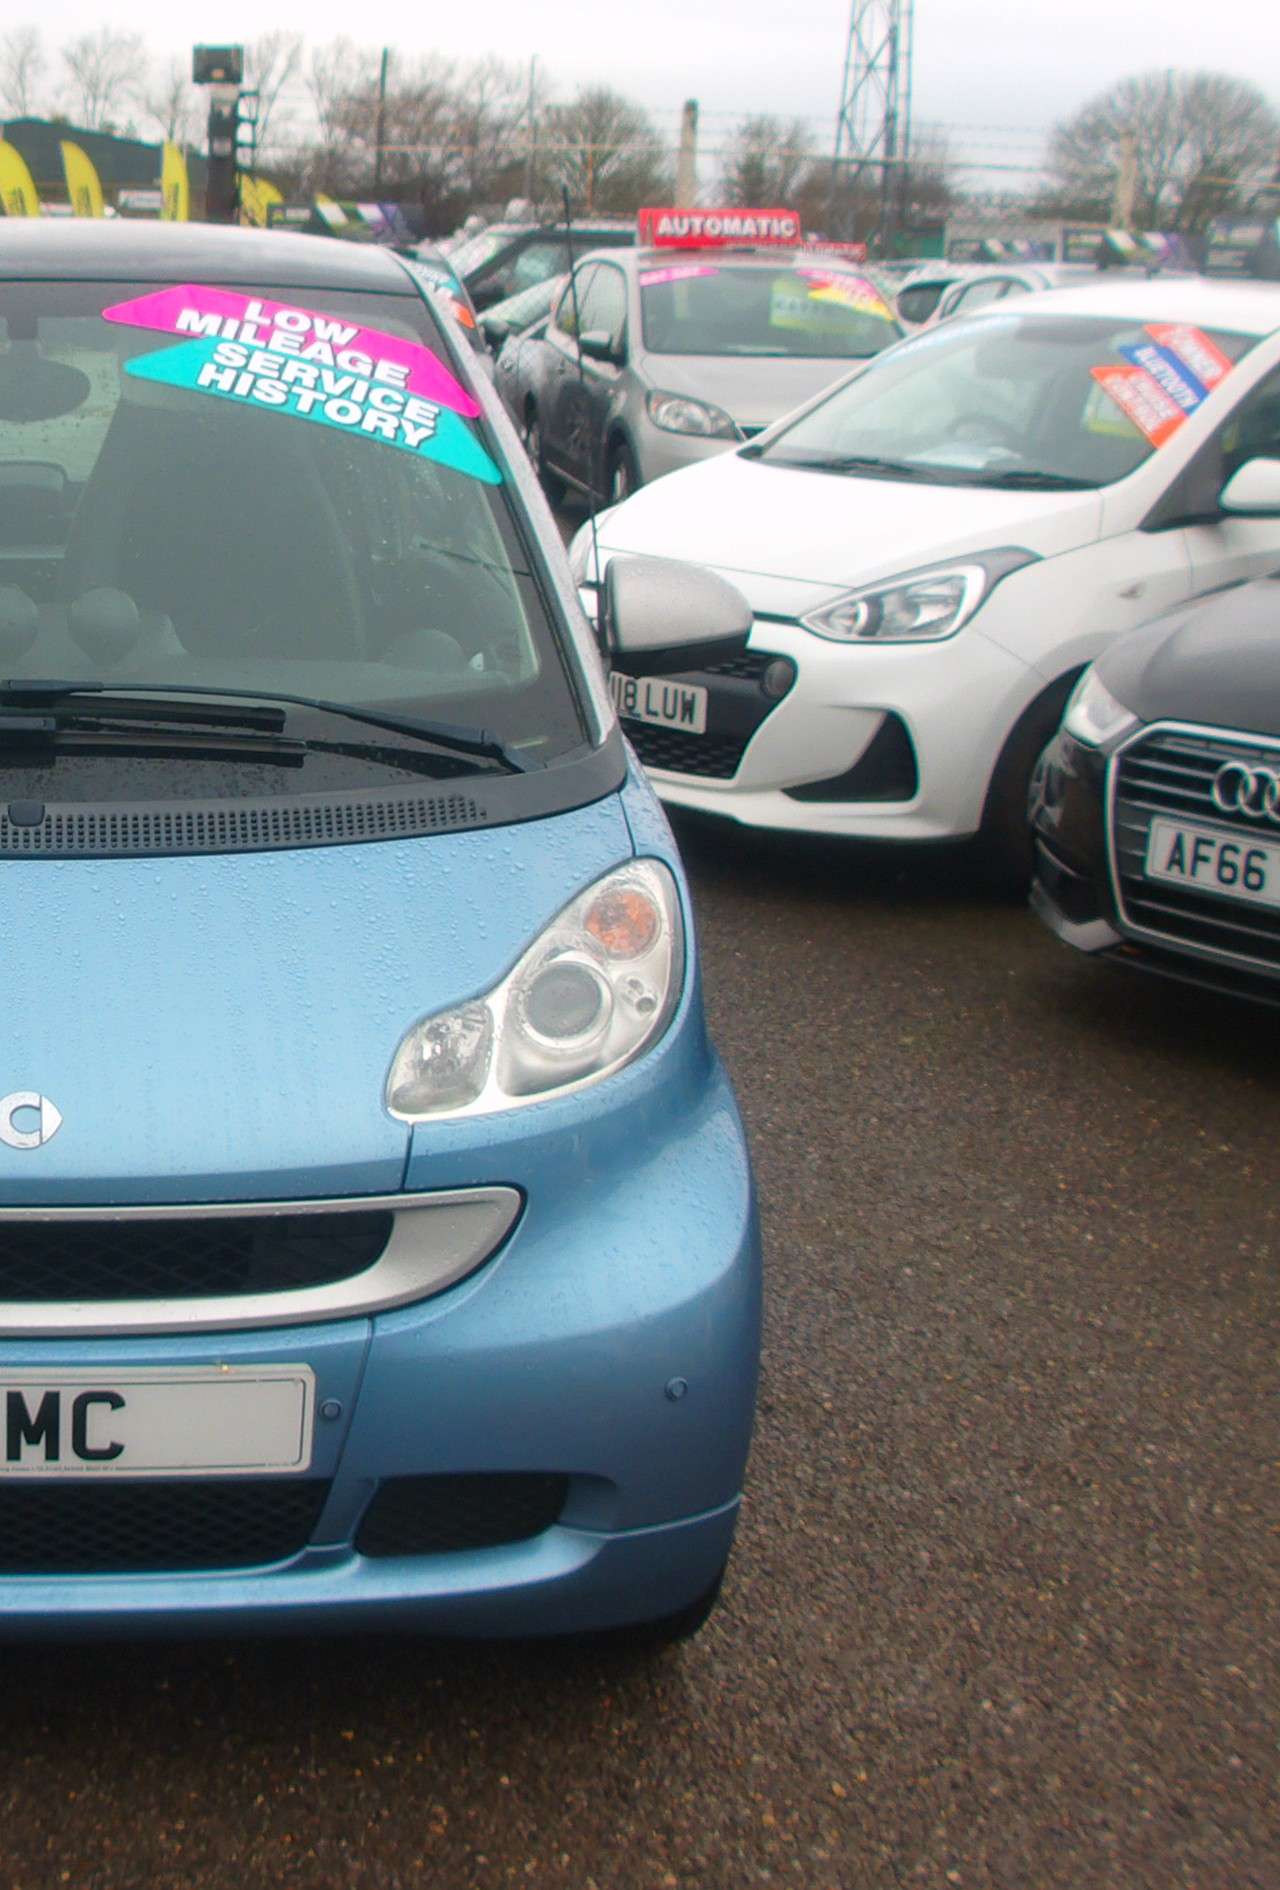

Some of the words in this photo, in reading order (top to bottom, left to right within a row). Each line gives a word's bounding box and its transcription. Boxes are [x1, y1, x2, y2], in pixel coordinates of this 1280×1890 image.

[657, 216, 797, 238] AUTOMATIC
[175, 309, 412, 389] MILEAGE
[243, 301, 360, 346] LOW
[196, 362, 435, 448] HISTORY
[213, 342, 442, 429] SERVICE
[644, 683, 697, 725] LUW
[1166, 832, 1267, 892] AF66
